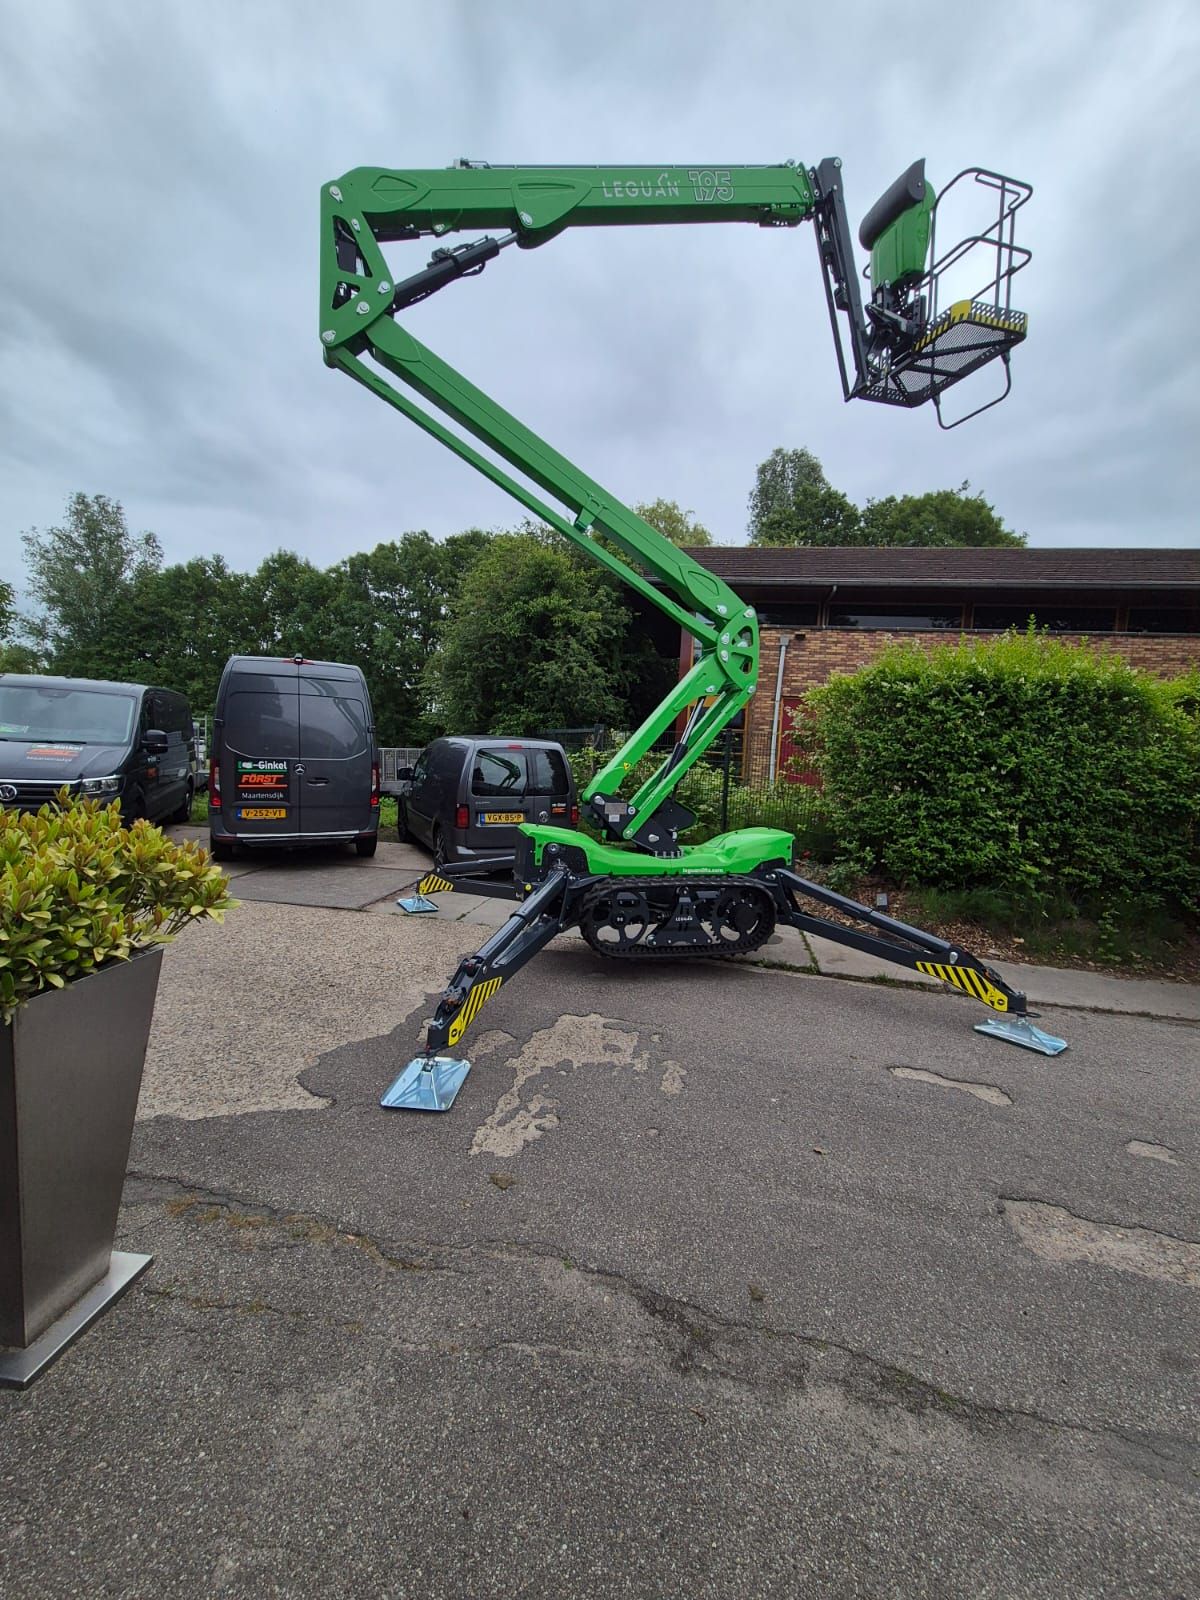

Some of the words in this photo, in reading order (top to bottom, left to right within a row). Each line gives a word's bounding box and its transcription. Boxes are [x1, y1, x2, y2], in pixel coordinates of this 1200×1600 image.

[602, 173, 680, 198] LEGUAN
[688, 170, 735, 202] 195
[241, 774, 285, 783] FÖRST
[241, 792, 284, 800] Maartensdijk
